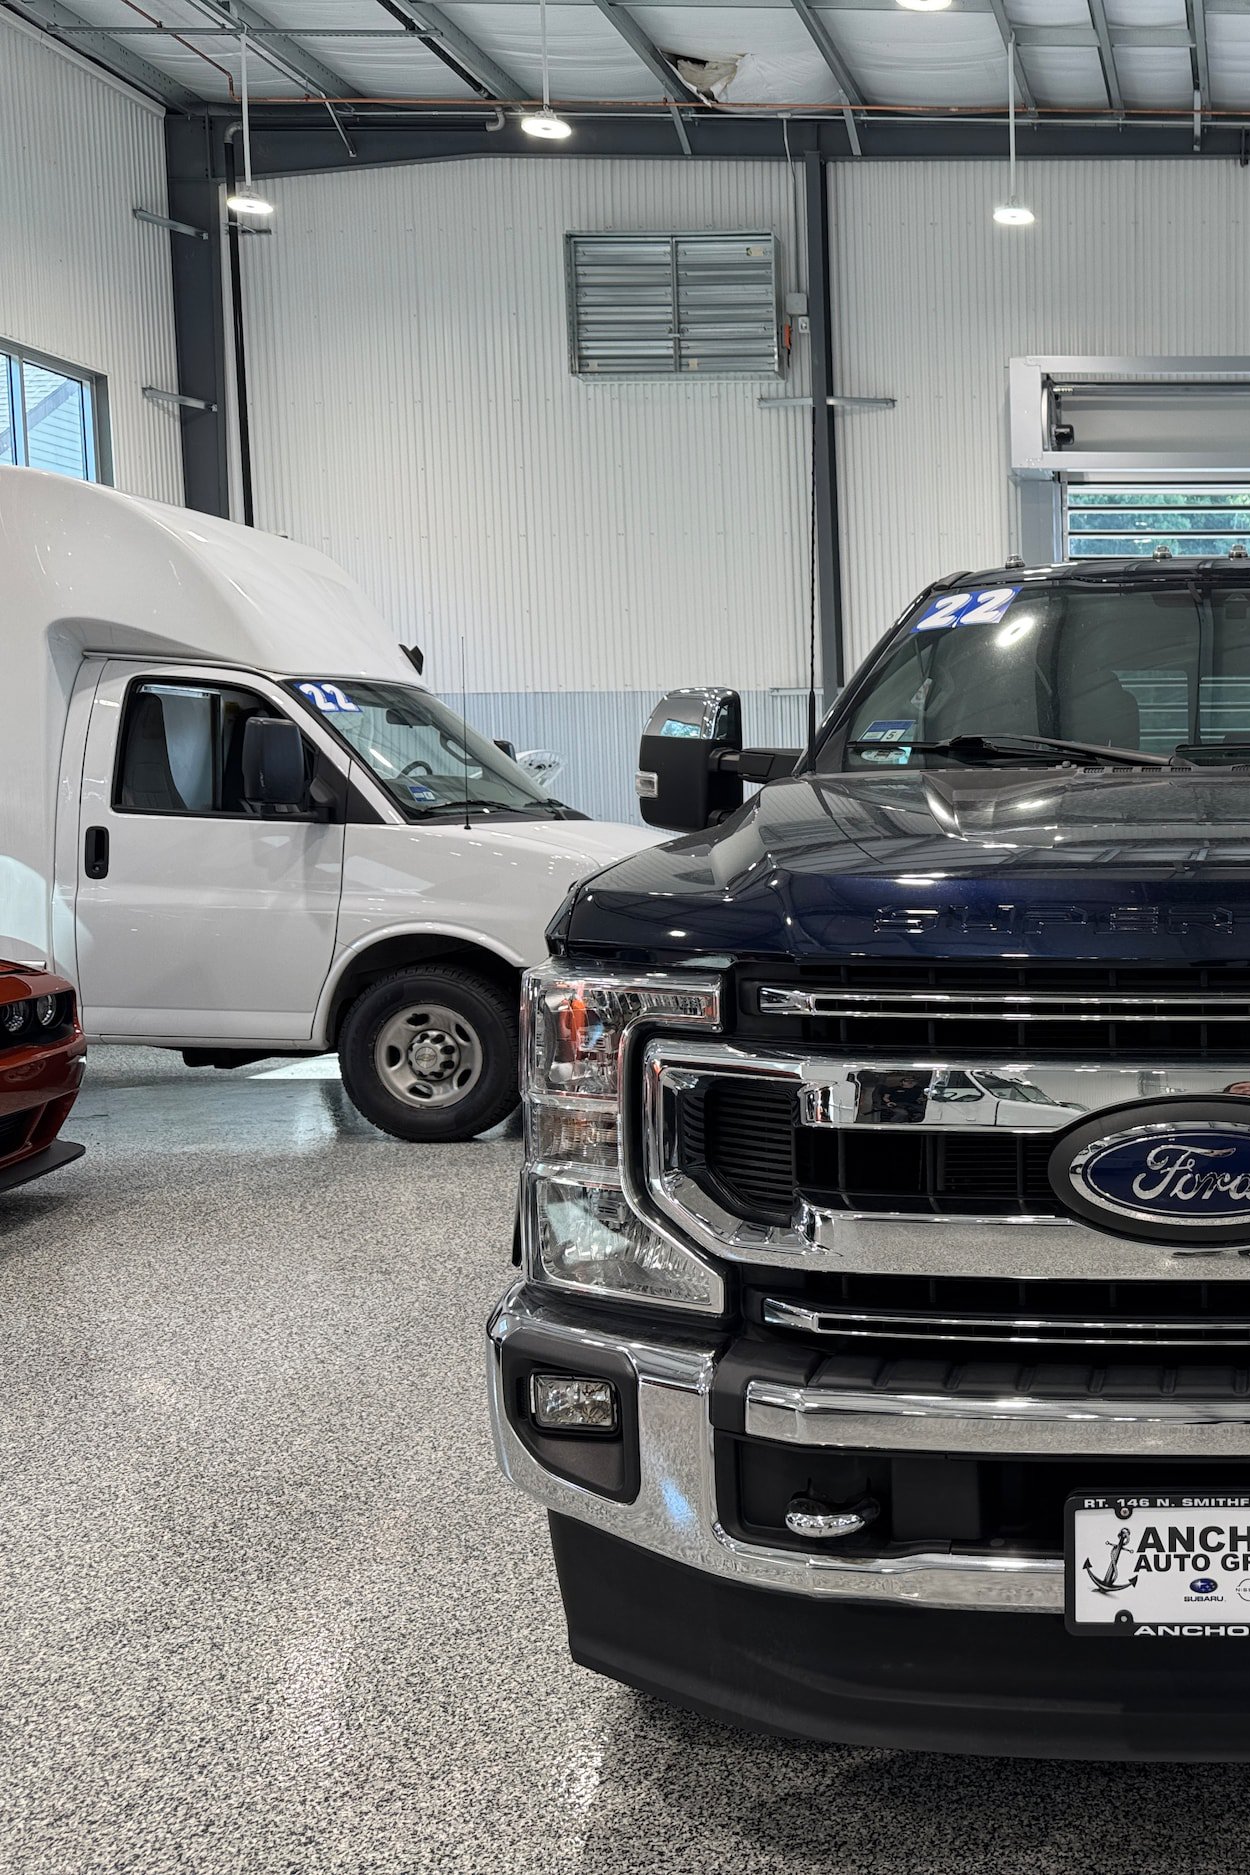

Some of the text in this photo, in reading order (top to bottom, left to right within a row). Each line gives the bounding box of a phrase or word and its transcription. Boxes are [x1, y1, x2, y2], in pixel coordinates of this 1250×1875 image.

[916, 588, 1016, 630] 22
[299, 683, 360, 712] 22
[886, 731, 897, 740] 5
[873, 904, 1234, 934] SUPER
[1084, 1499, 1108, 1508] RT.
[1117, 1498, 1150, 1507] 146
[1156, 1499, 1175, 1507] N.
[1133, 1553, 1211, 1573] AUTO
